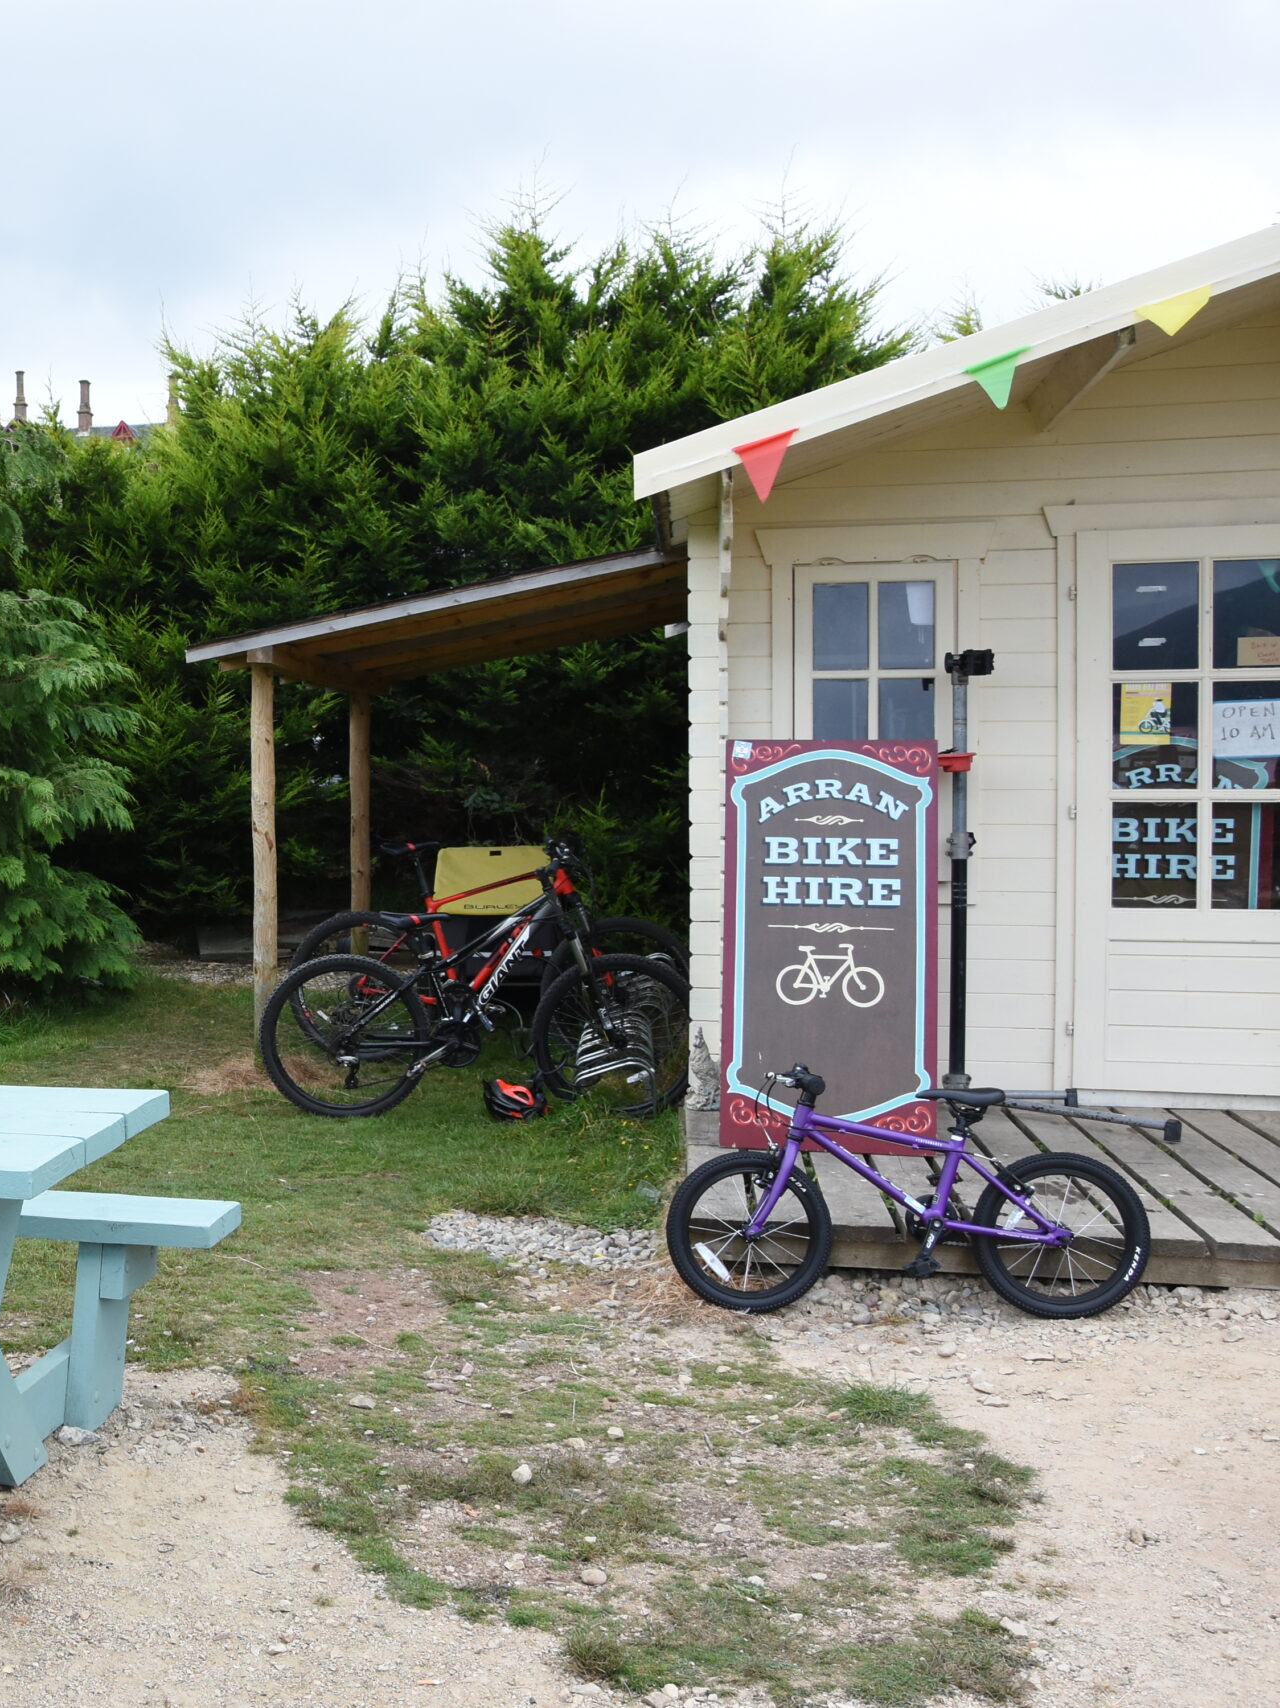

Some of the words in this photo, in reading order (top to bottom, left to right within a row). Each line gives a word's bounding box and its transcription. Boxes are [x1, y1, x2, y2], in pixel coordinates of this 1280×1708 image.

[1222, 702, 1276, 718] OPEN
[1220, 727, 1240, 741] 10
[1250, 724, 1276, 740] AM
[758, 778, 909, 823] ARRAN
[1112, 818, 1236, 843] BIKE
[763, 836, 900, 866] BIKE
[1112, 854, 1236, 879] HIRE
[762, 876, 901, 907] HIRE
[1123, 1245, 1142, 1282] KENDA
